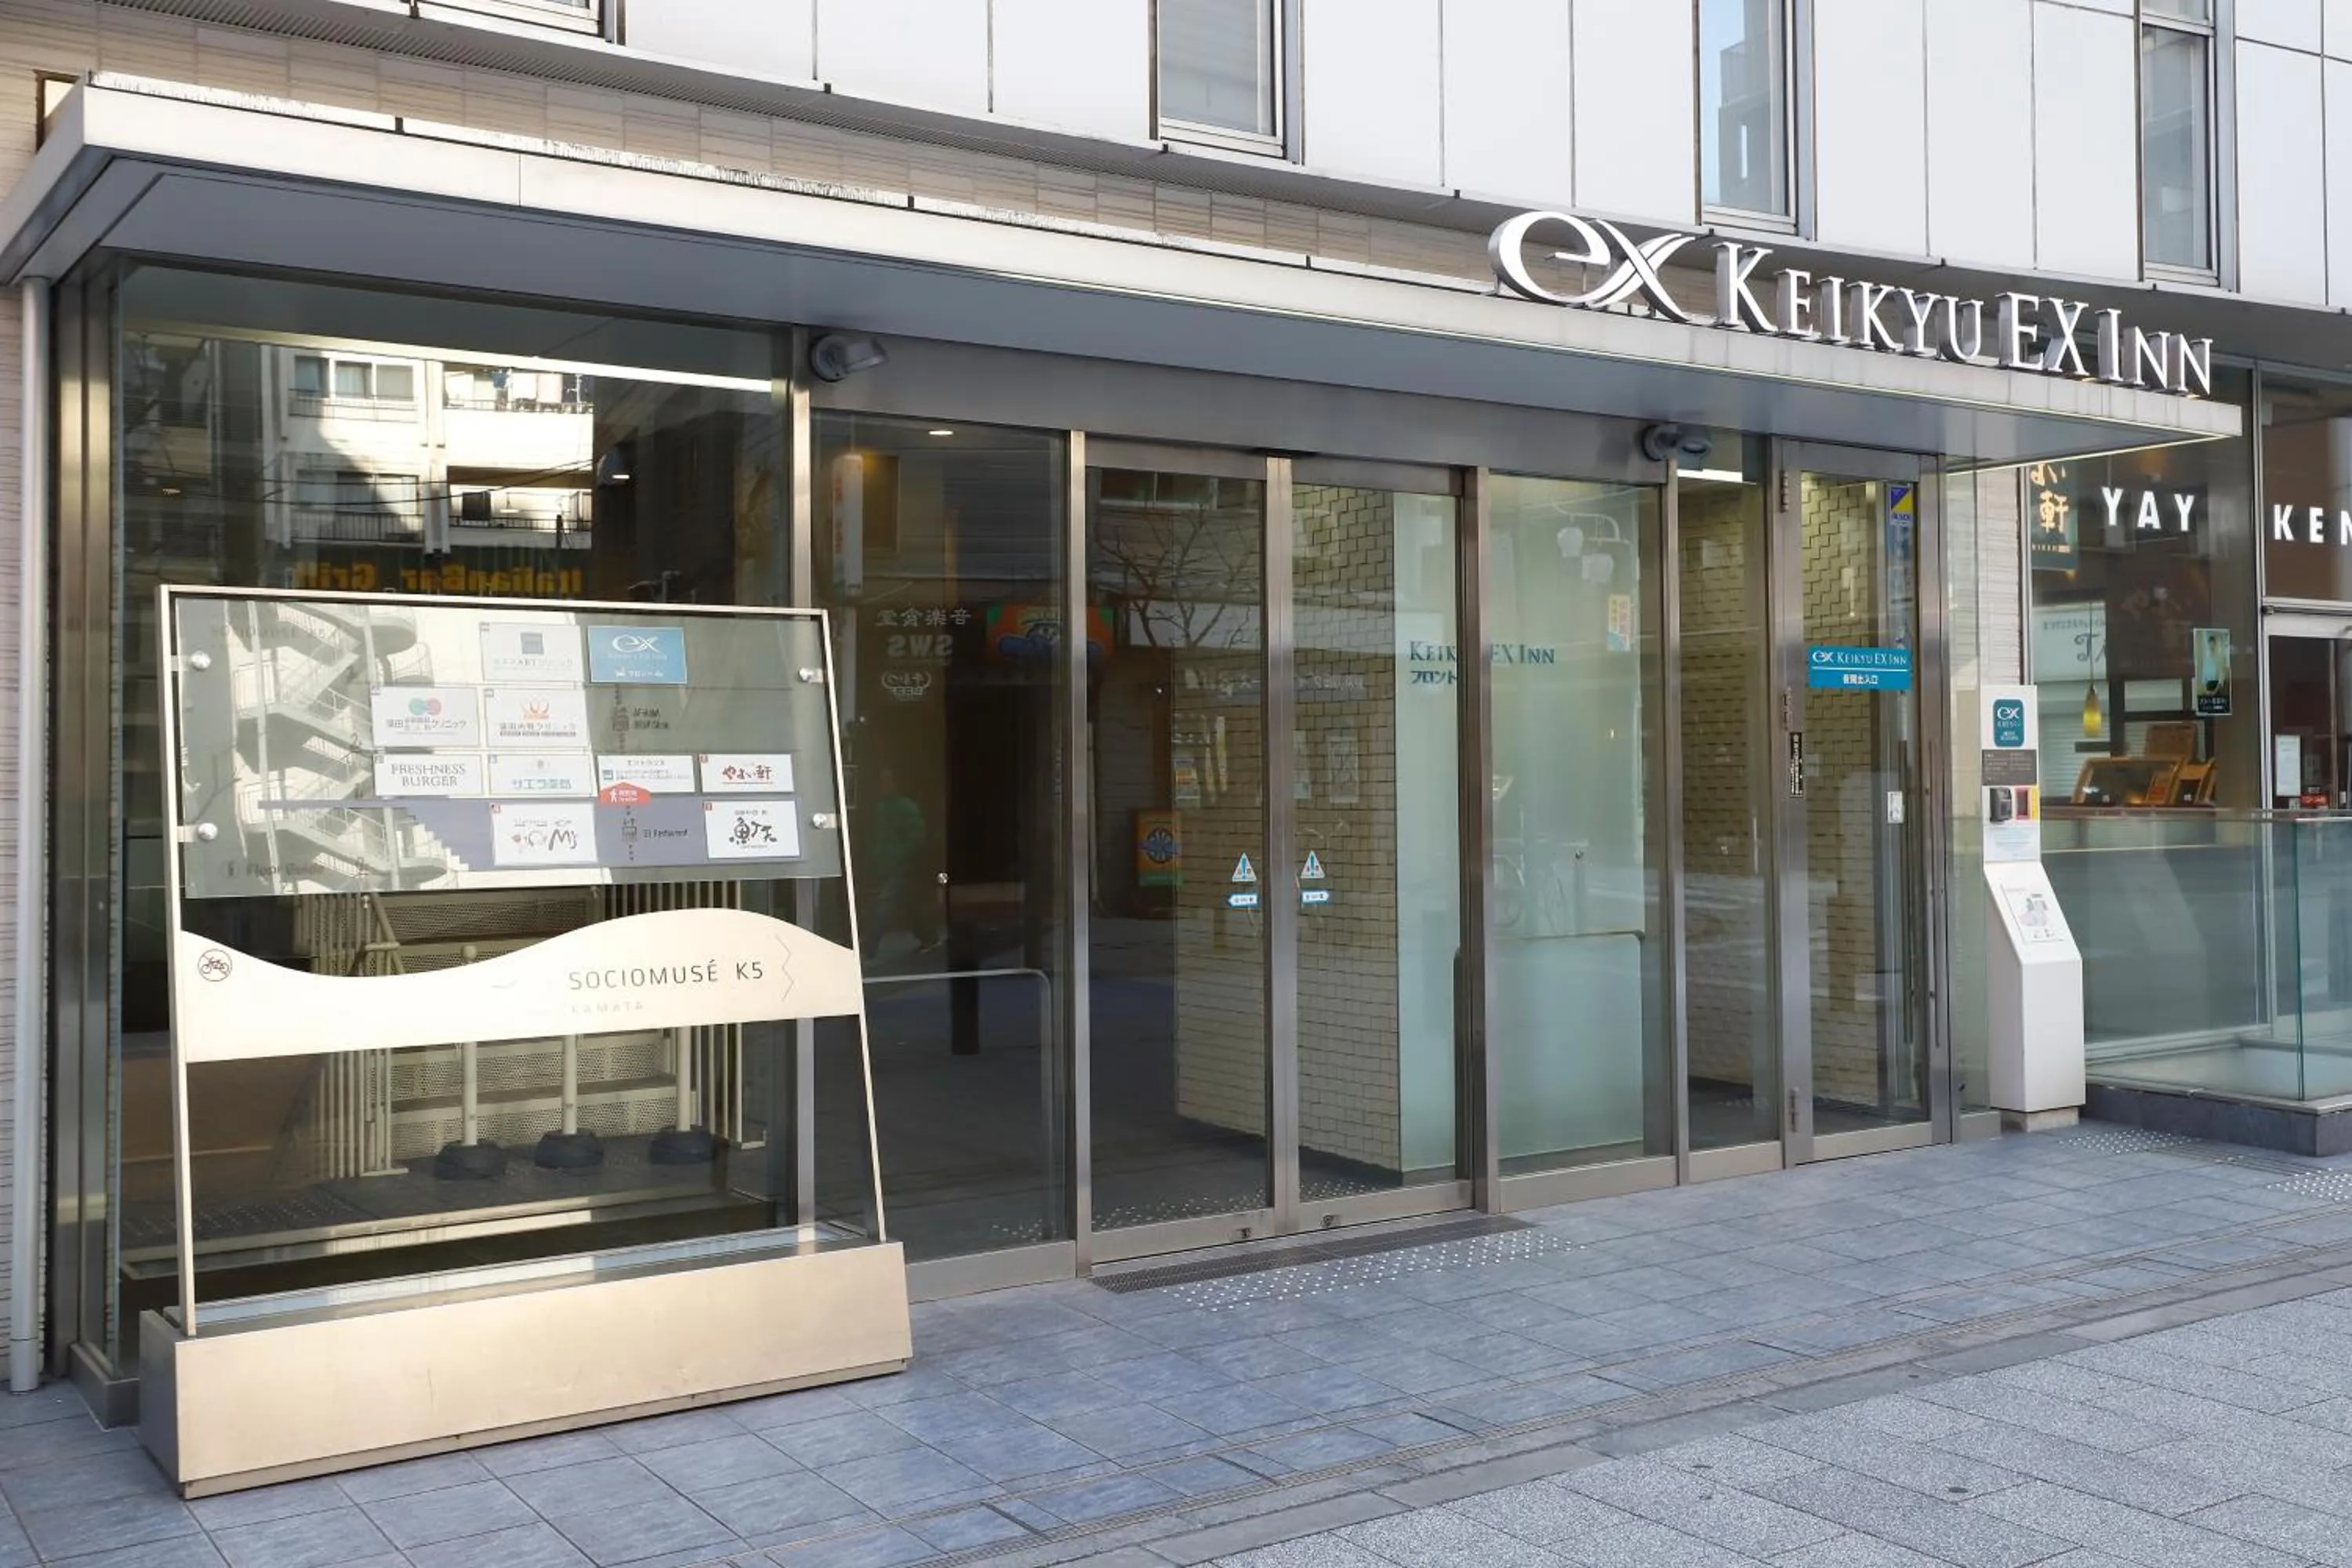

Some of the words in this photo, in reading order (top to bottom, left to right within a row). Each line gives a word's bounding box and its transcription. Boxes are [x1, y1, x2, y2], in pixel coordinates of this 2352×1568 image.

[1715, 243, 1984, 363] KEIKYU
[1998, 291, 2091, 376] EX
[2096, 307, 2213, 396] INN
[1409, 641, 1456, 662] KEIK
[1519, 644, 1556, 665] INN
[1875, 652, 1888, 665] EX
[1410, 670, 1457, 684] フロント
[391, 763, 466, 775] FRESHNESS
[401, 775, 458, 787] BURGER
[568, 960, 720, 991] SOCIOMUSÉ
[735, 960, 764, 981] K5
